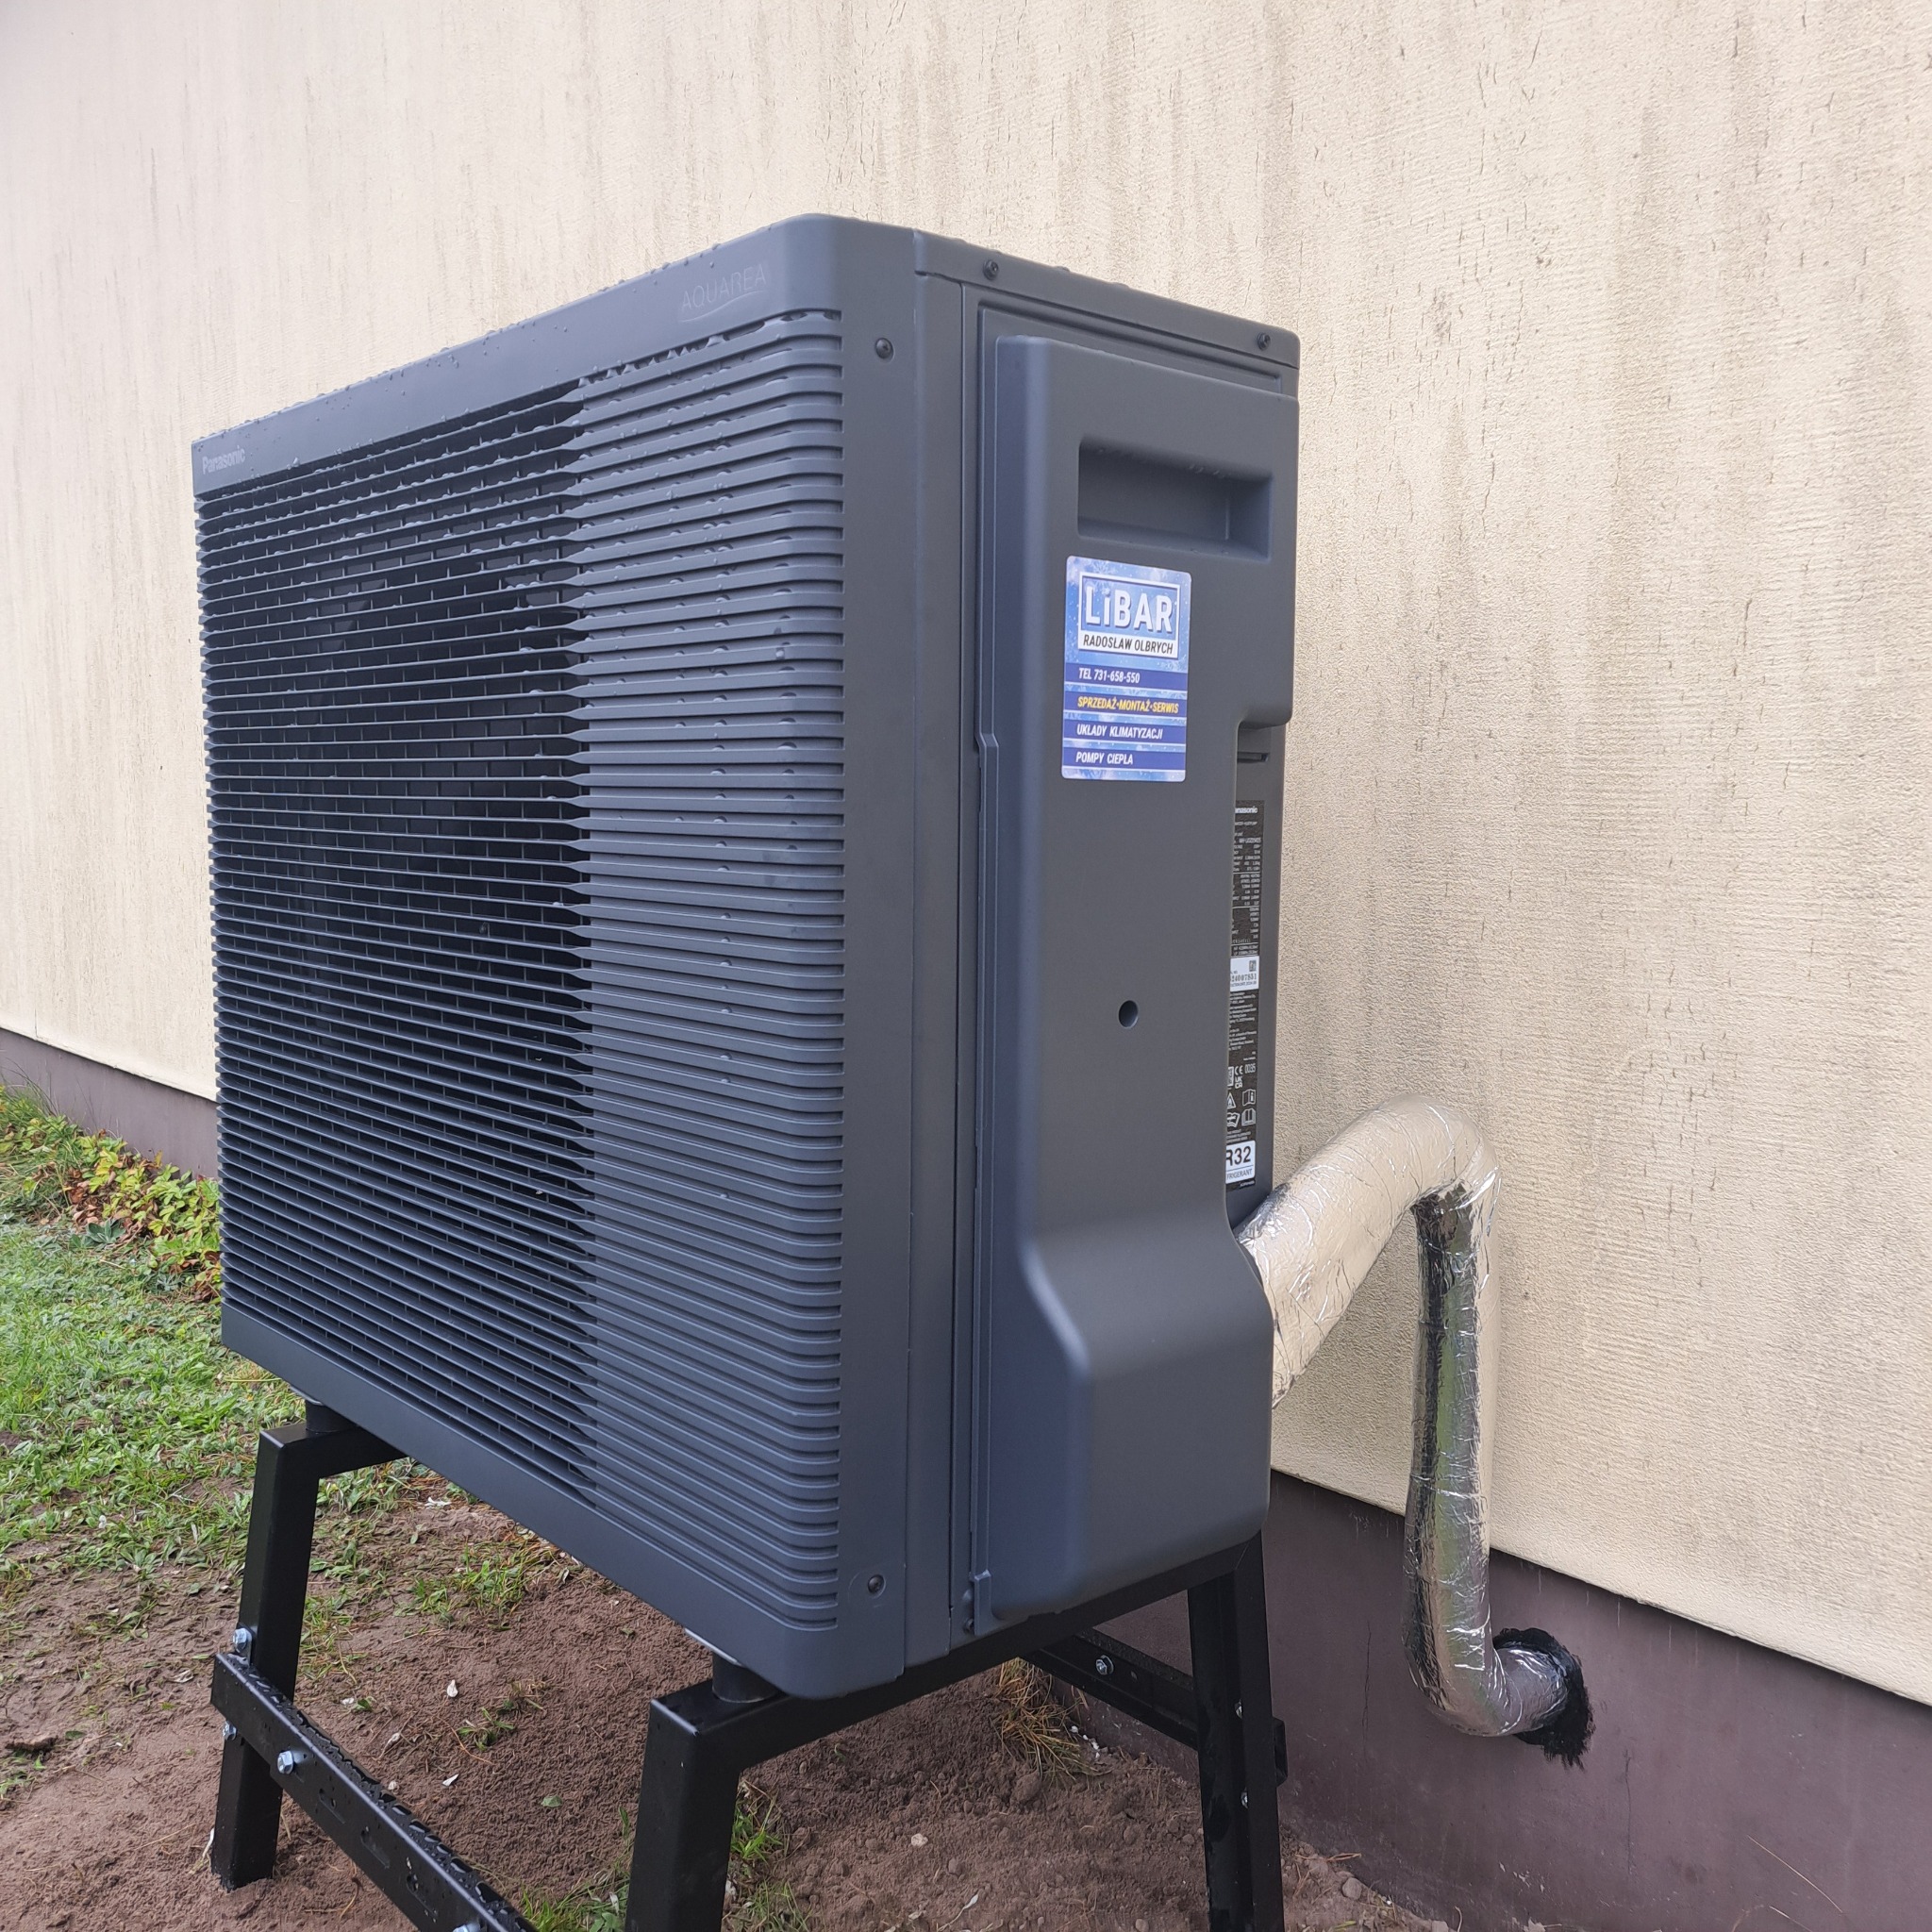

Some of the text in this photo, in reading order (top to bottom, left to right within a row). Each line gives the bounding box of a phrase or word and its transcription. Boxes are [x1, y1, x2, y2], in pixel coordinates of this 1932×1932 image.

[682, 264, 766, 311] AQUAREA
[202, 445, 246, 475] Panasonic
[1134, 640, 1174, 654] OLBRYCH
[1078, 667, 1141, 683] TEL 731-658-550
[1109, 725, 1164, 740] KLIMATYZACJI
[1075, 751, 1105, 764] POMPY
